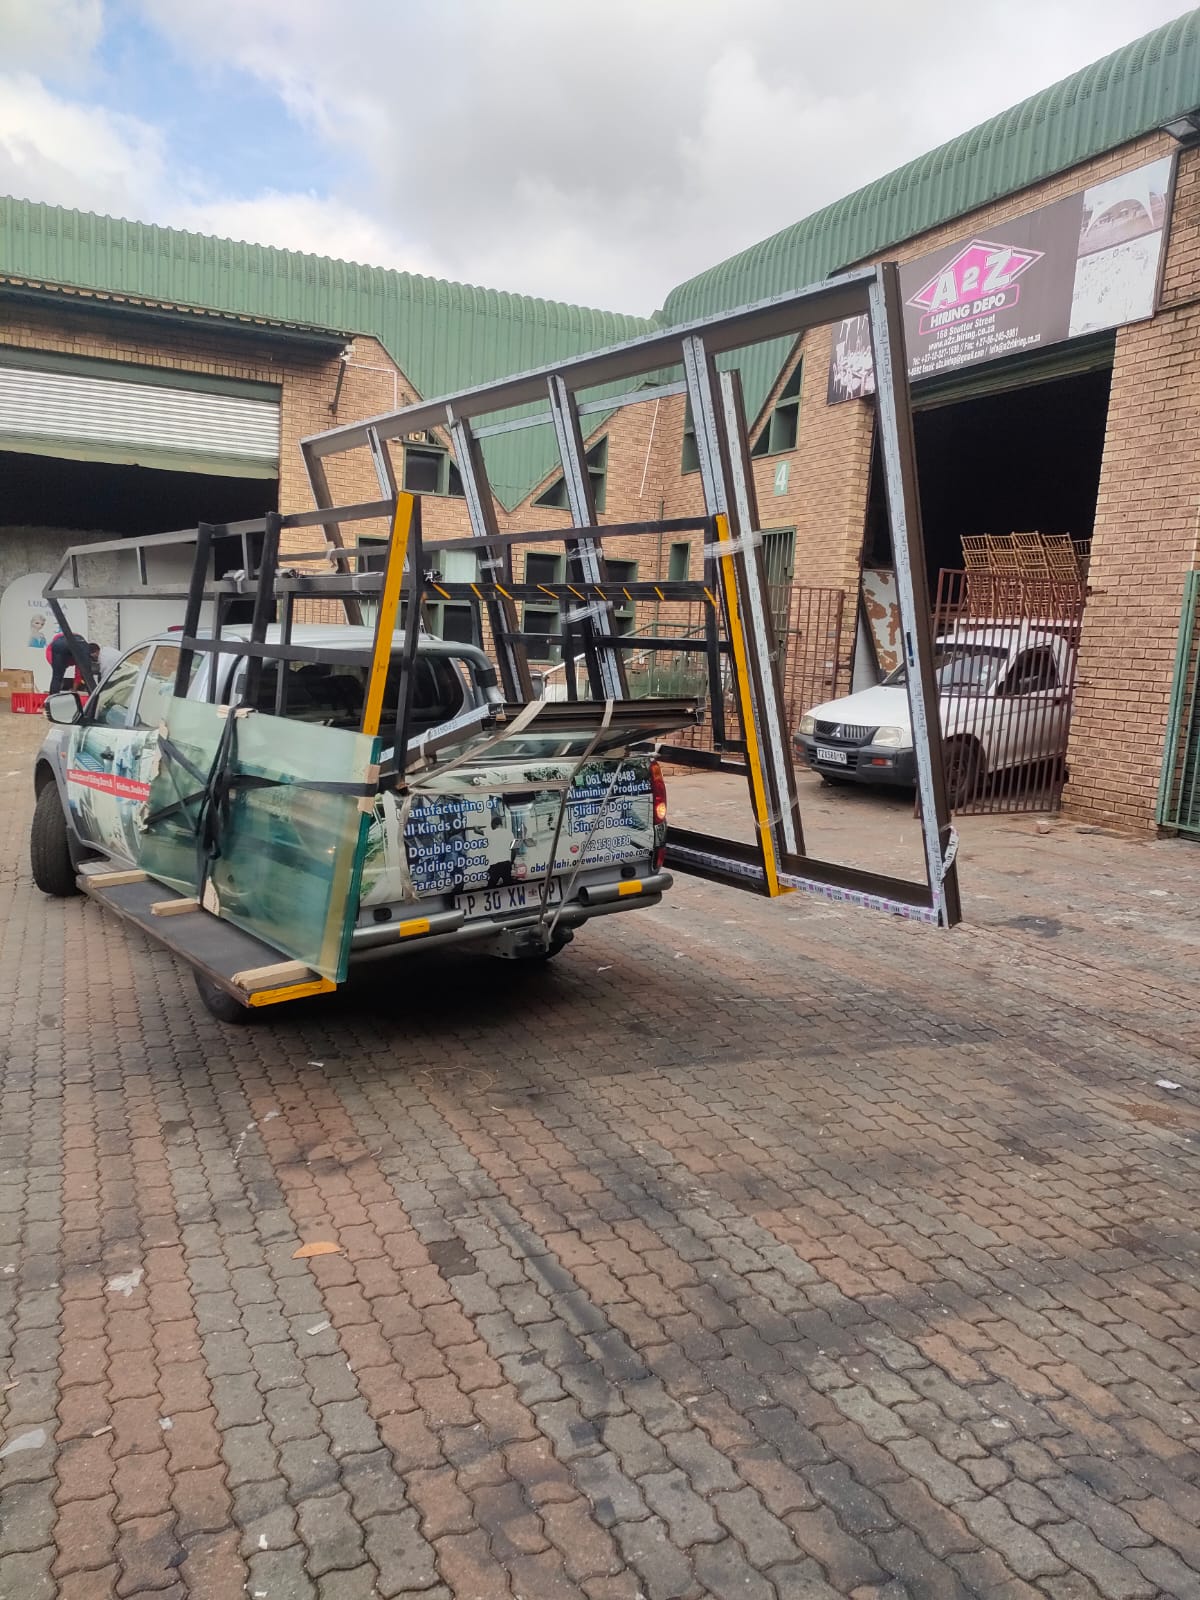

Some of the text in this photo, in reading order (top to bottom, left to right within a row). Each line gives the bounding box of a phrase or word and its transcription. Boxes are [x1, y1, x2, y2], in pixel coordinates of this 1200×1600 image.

[928, 248, 1012, 312] A2Z
[930, 292, 1006, 328] HIRING DEPO
[974, 314, 996, 328] Street
[775, 464, 787, 490] 4
[566, 781, 652, 800] Aluminiu Products:
[486, 797, 499, 809] of
[573, 802, 608, 818] Sliding
[417, 820, 451, 835] Kinds
[452, 816, 468, 830] Of
[409, 839, 488, 858] Double Doors
[409, 855, 489, 877] Folding Door,
[484, 891, 502, 911] 30
[507, 886, 526, 907] XW
